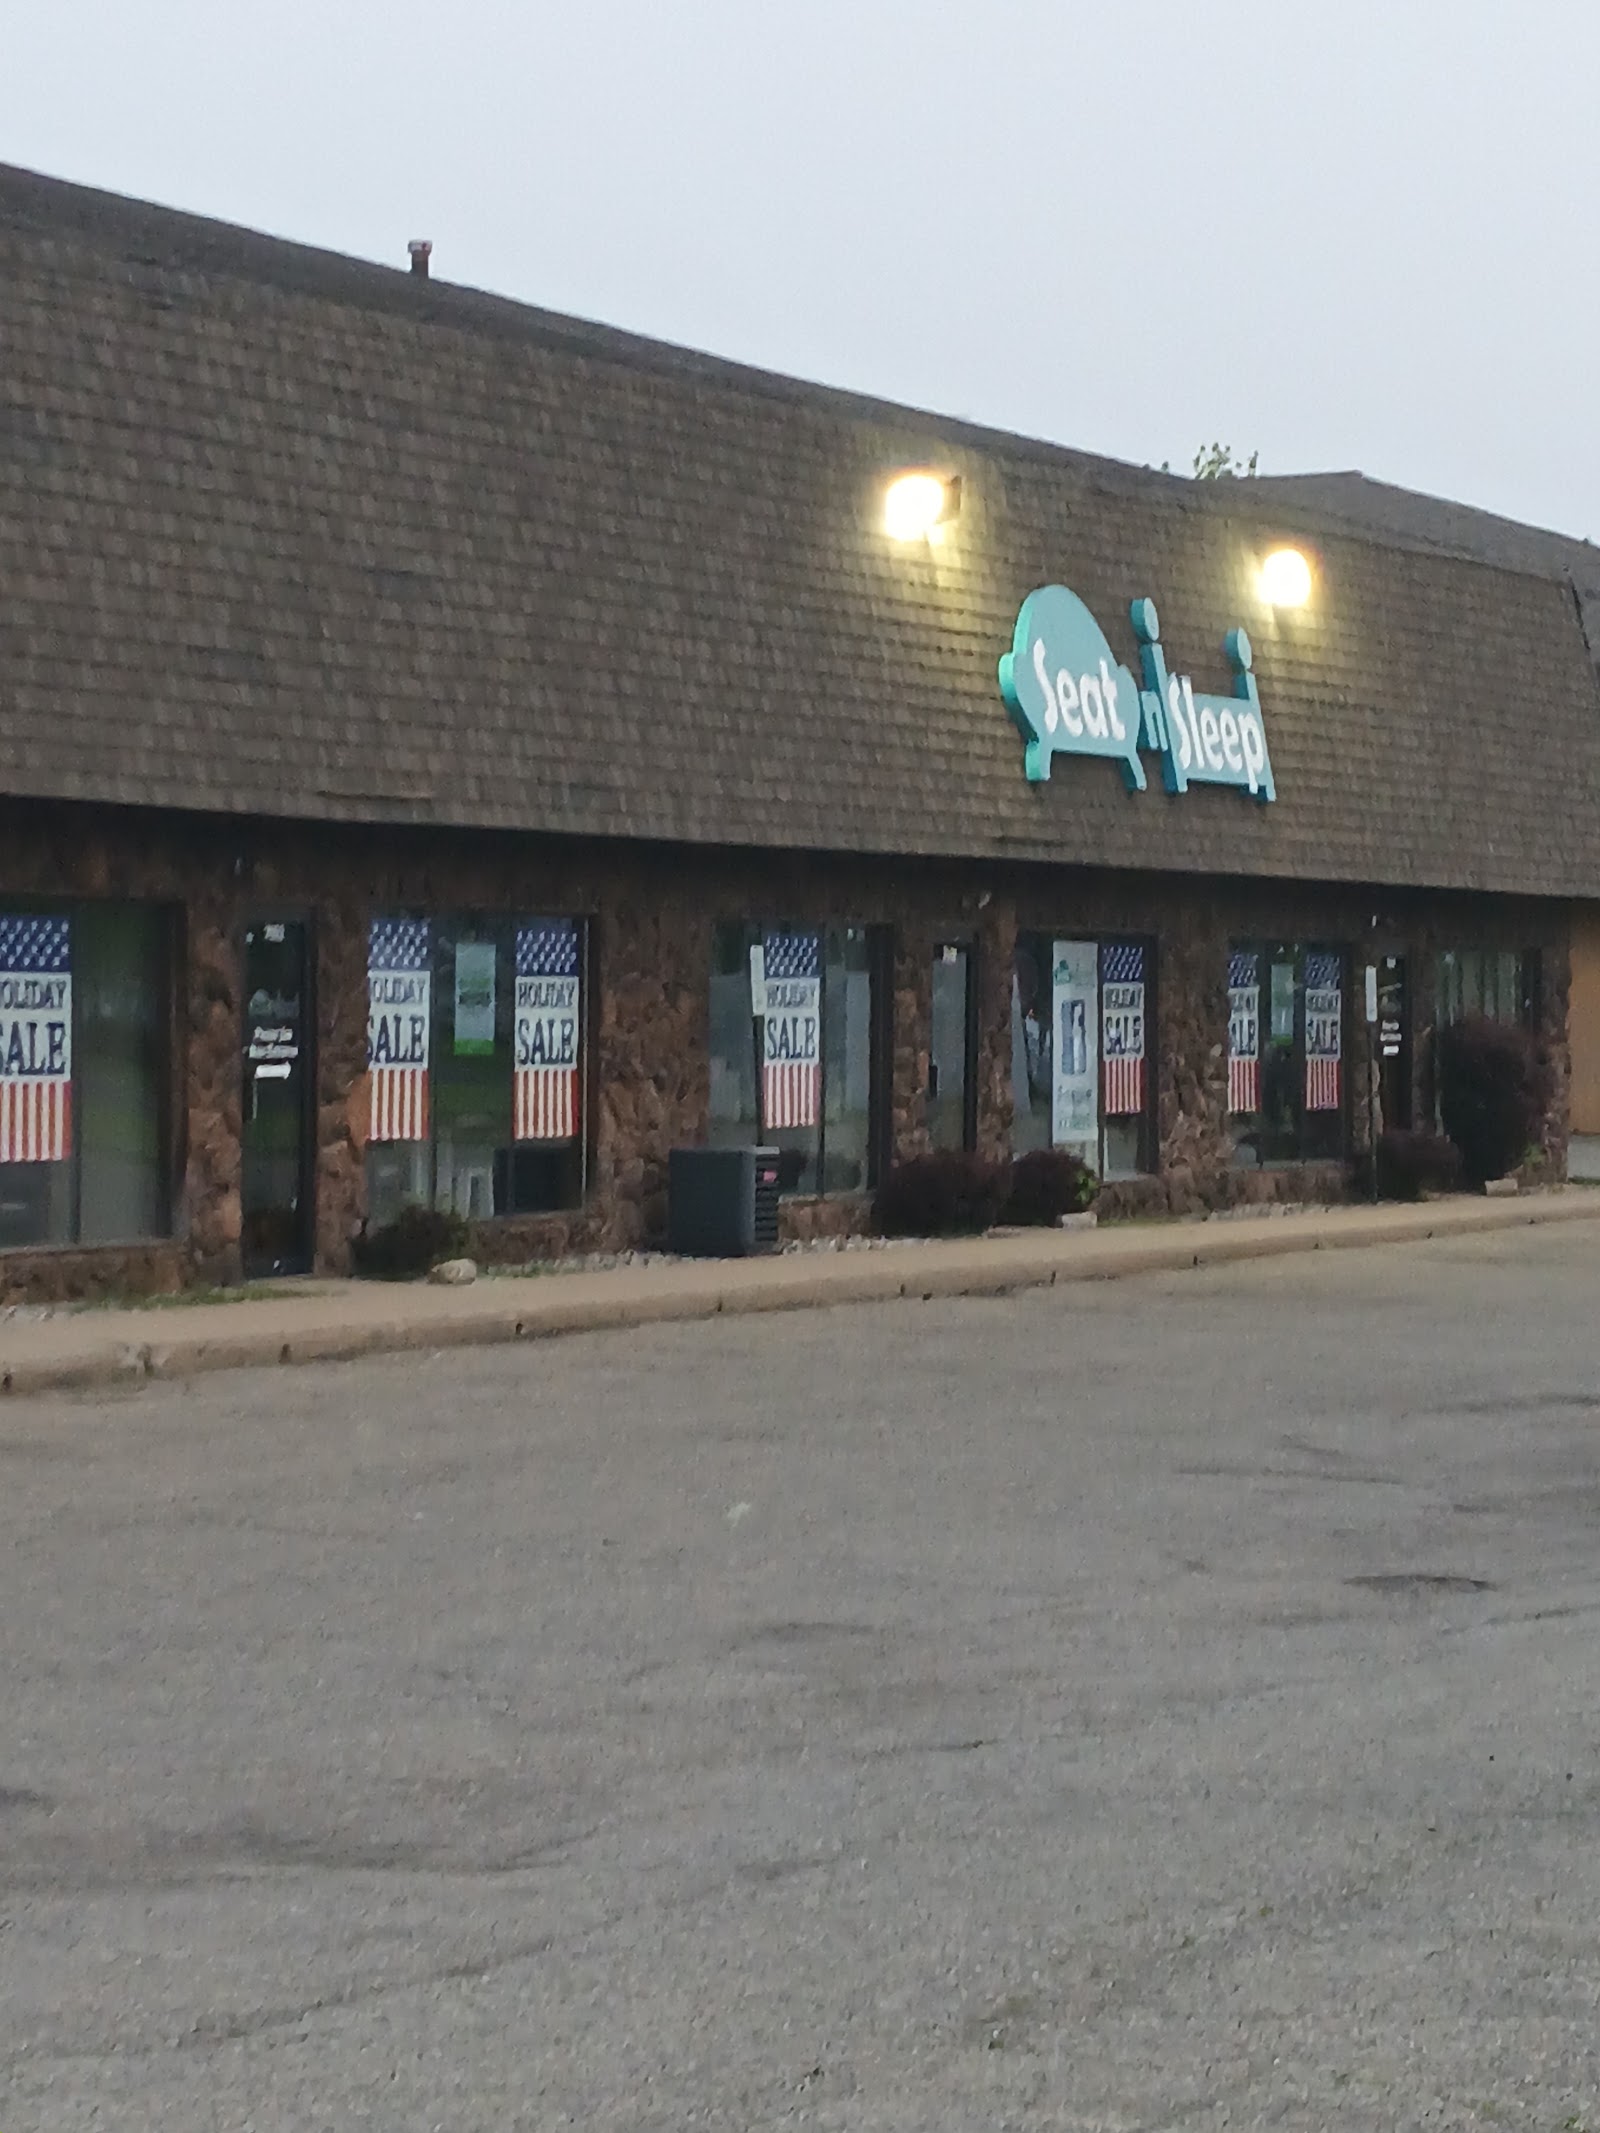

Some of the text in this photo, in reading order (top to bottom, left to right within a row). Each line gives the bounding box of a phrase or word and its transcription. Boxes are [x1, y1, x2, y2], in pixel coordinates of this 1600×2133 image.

[1033, 638, 1125, 741] Seat
[1168, 672, 1264, 794] Sleep
[0, 978, 66, 1009] OLIDAY
[366, 977, 426, 1005] OLIDAY
[0, 1021, 66, 1075] ALE
[518, 1018, 574, 1065] SALE
[767, 1016, 816, 1059] SALE
[1228, 1019, 1256, 1056] ALE
